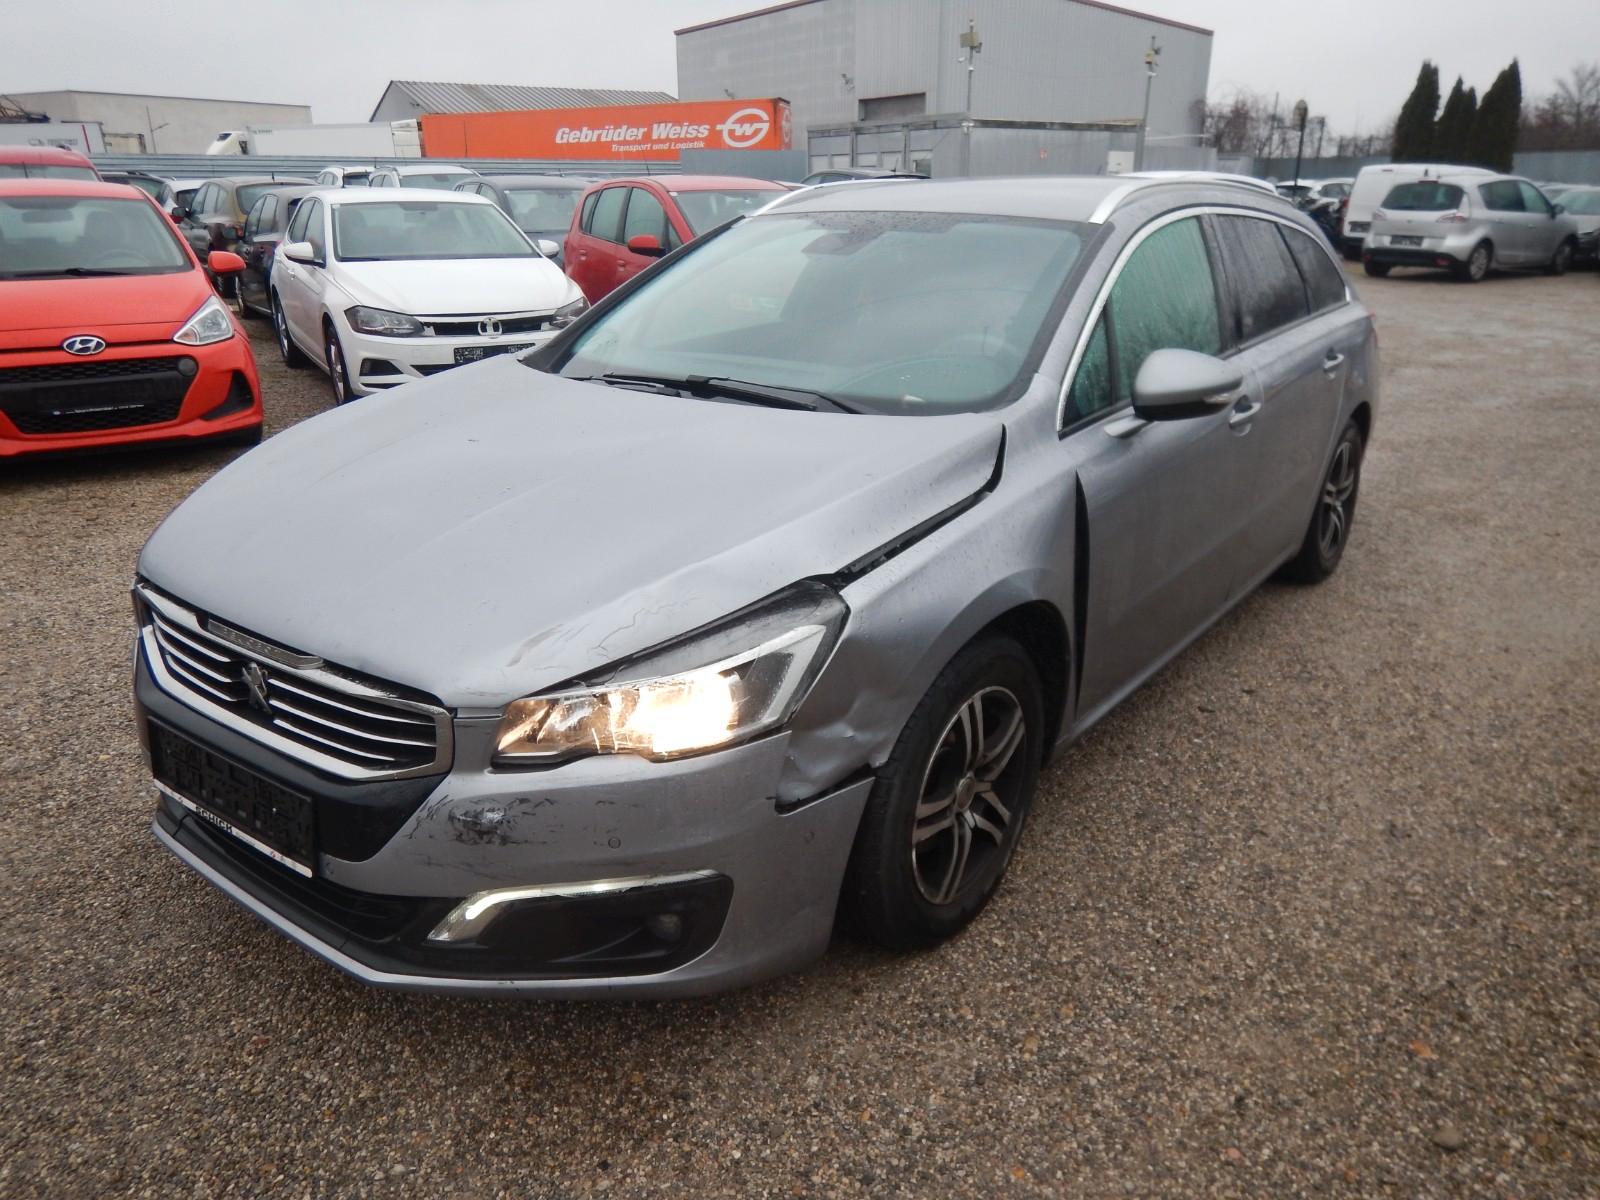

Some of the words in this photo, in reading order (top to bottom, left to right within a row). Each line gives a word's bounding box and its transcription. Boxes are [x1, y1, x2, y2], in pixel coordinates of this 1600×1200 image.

[555, 125, 647, 144] Gebrüder
[652, 122, 710, 140] Weiss
[611, 143, 651, 152] Transport
[652, 142, 669, 151] und
[670, 140, 705, 150] Logistik
